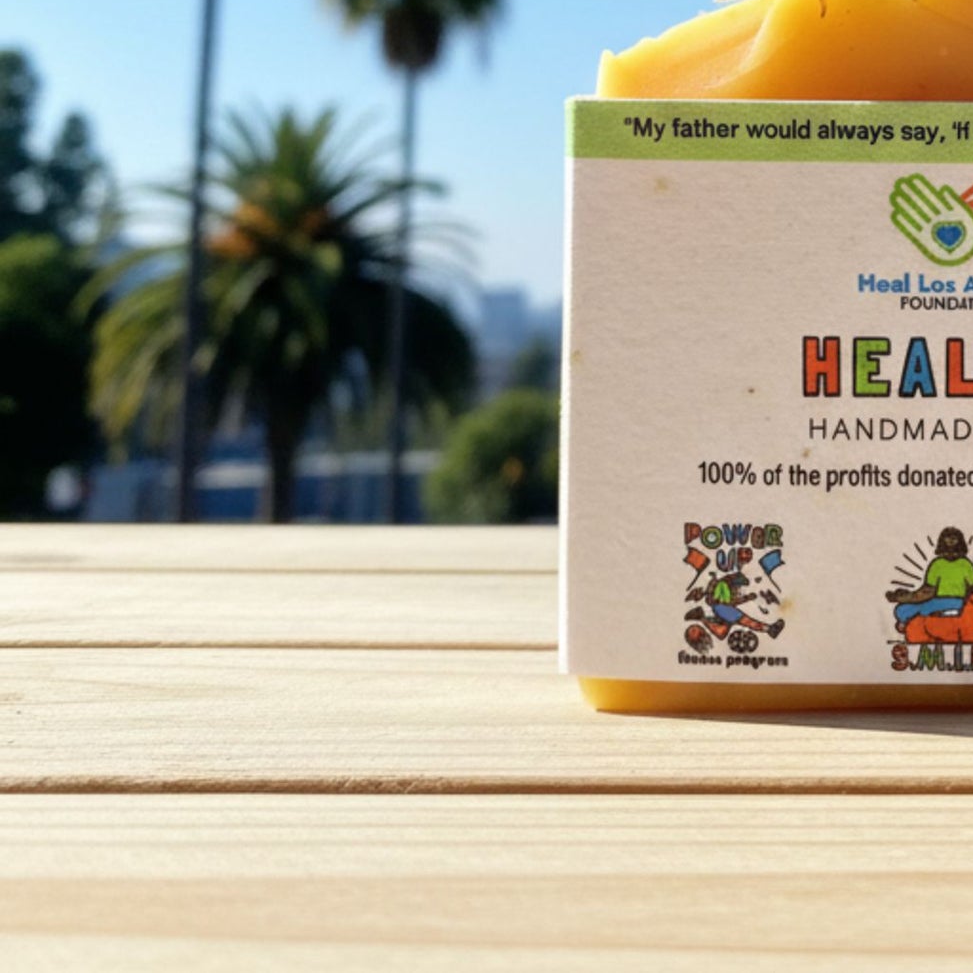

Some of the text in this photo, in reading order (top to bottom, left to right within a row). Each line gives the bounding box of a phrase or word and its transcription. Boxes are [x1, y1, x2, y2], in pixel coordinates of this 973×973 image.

[672, 118, 739, 138] father
[746, 119, 811, 139] would
[818, 119, 894, 145] always
[901, 123, 946, 145] say,
[858, 273, 910, 293] Heal
[919, 273, 955, 293] Los
[698, 462, 756, 485] 100%
[763, 463, 783, 486] of
[789, 464, 820, 486] the
[826, 464, 891, 492] profits
[684, 522, 783, 549] POWER
